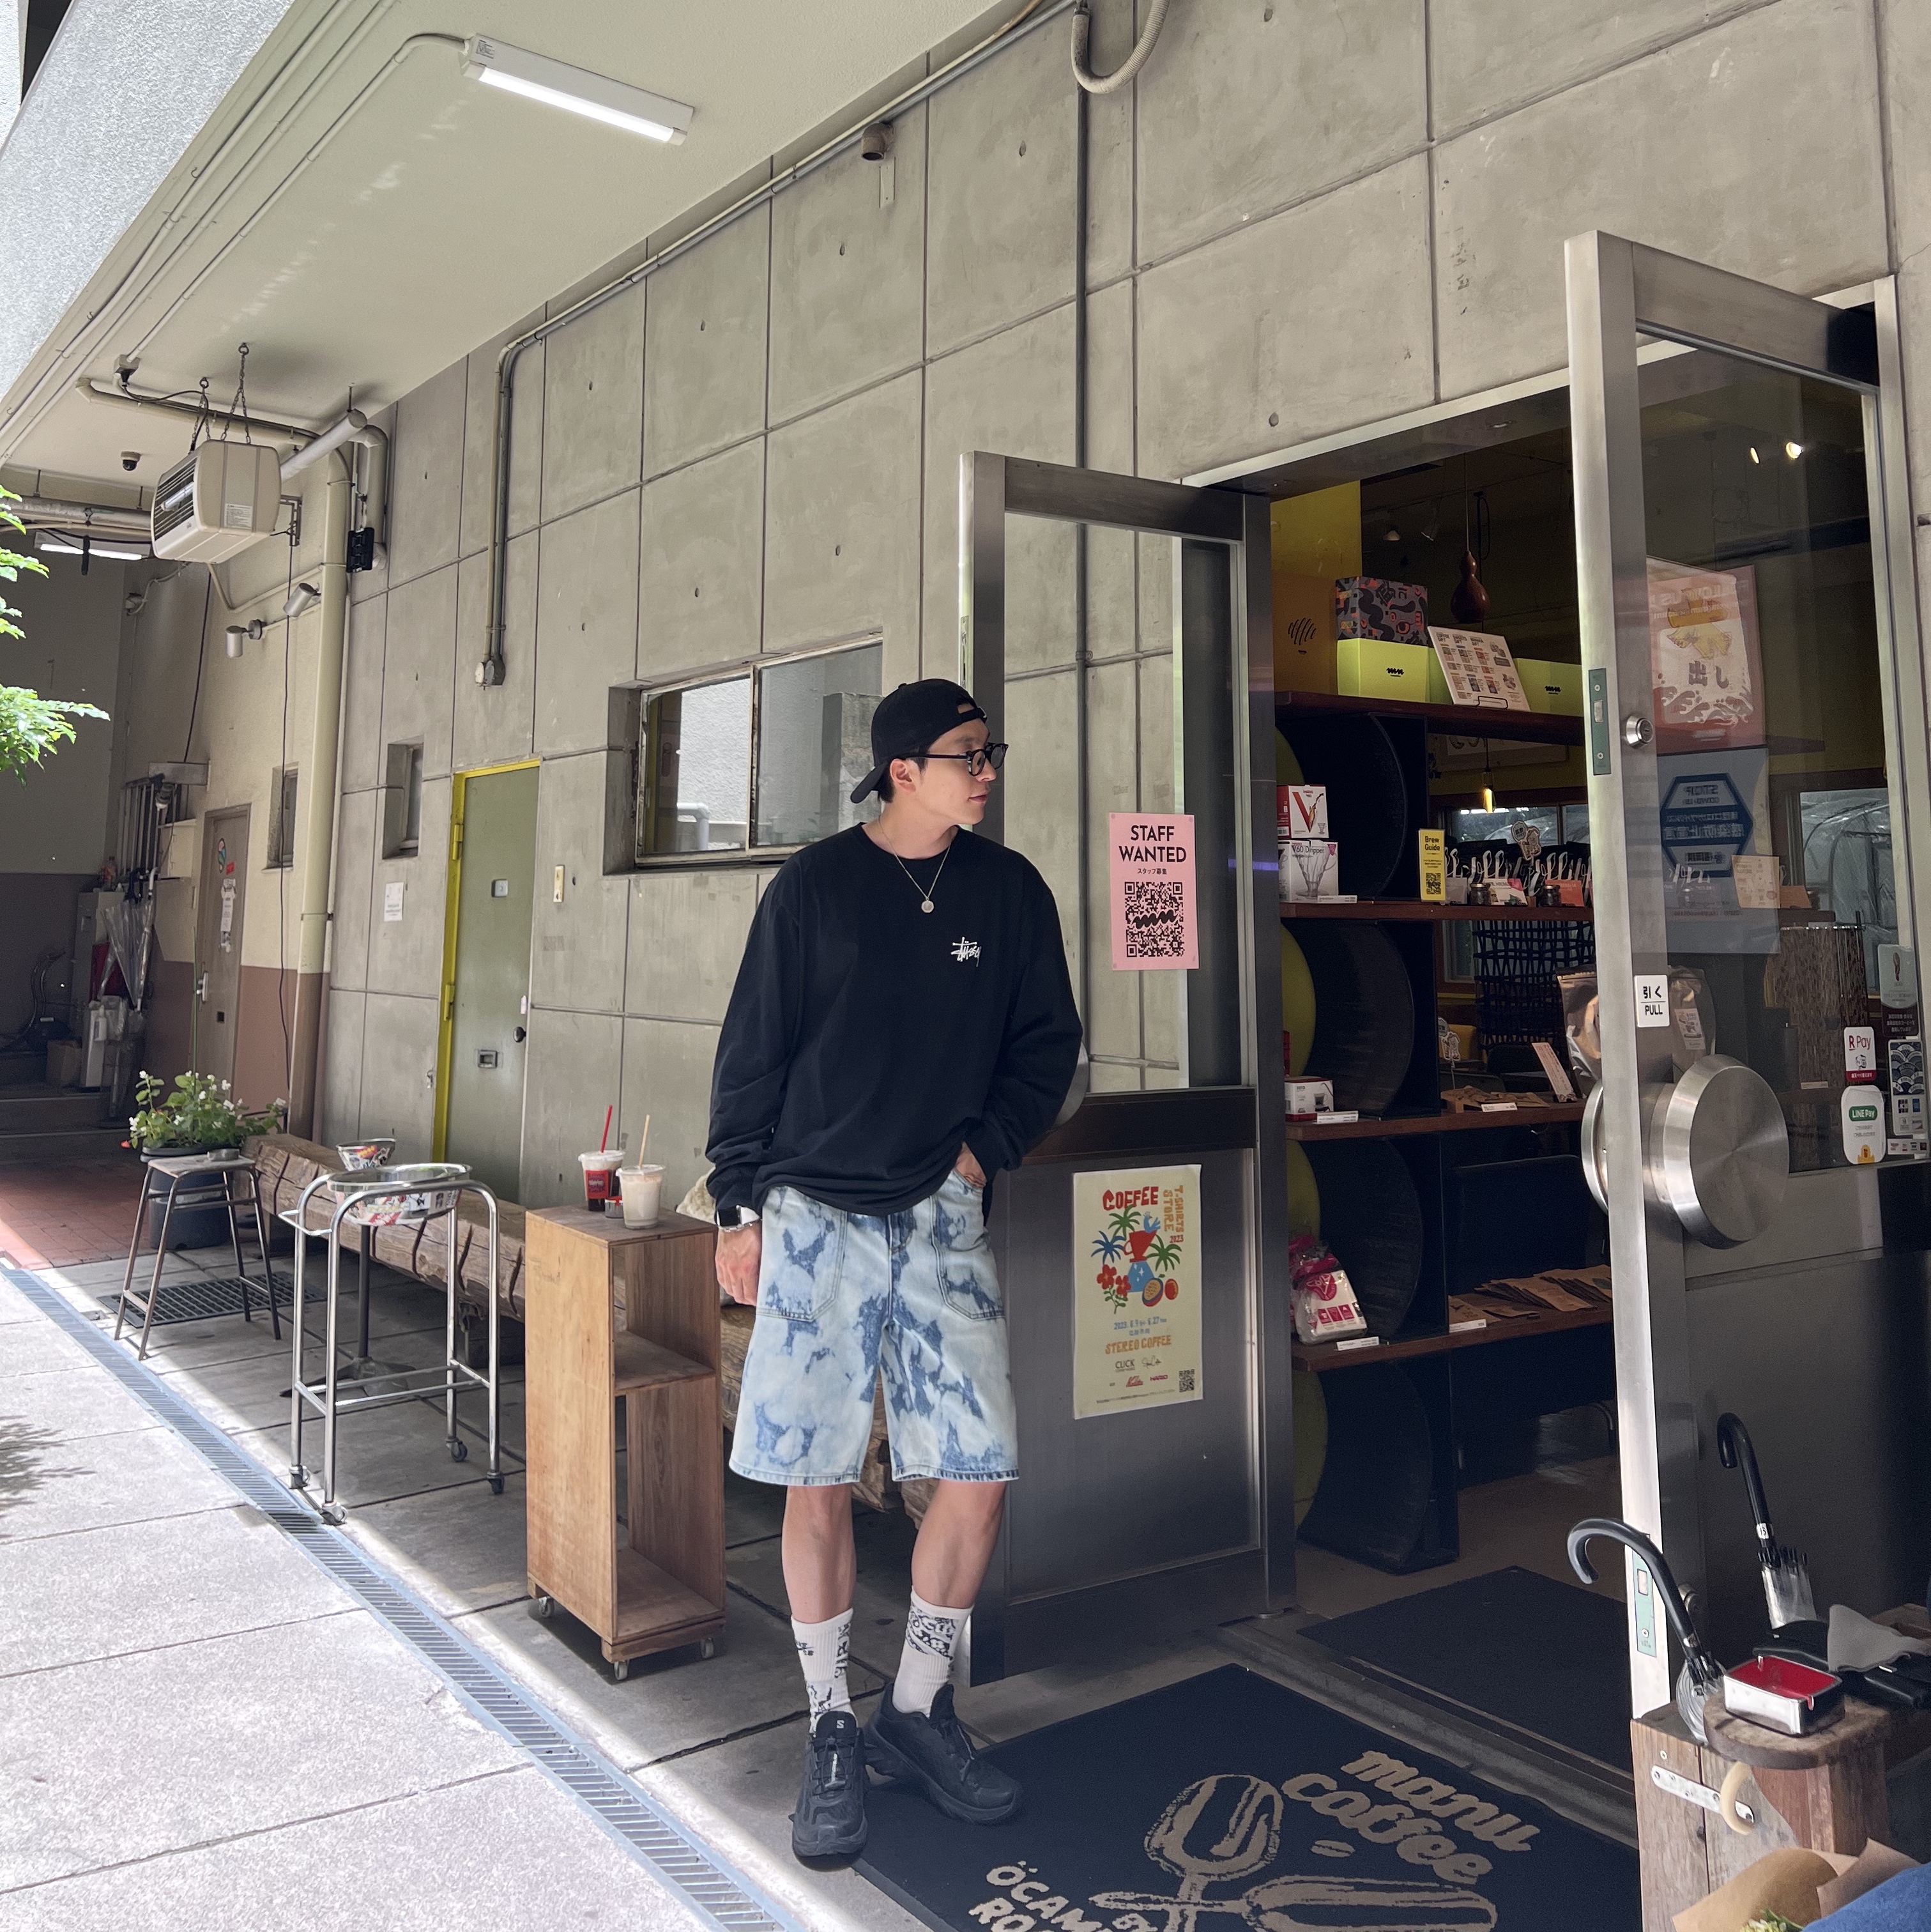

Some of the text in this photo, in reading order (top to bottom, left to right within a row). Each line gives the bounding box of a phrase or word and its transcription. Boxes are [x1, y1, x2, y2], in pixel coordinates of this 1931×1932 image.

[1131, 825, 1175, 841] STAFF
[1118, 845, 1187, 862] WANTED
[1305, 846, 1325, 855] Dripper
[1643, 985, 1662, 999] 引く
[1645, 1004, 1663, 1016] PULL
[1856, 1035, 1872, 1050] Pay
[1852, 1108, 1875, 1119] LINE Pay
[1103, 1186, 1159, 1211] COFFEE
[1163, 1189, 1174, 1232] STORE
[1174, 1184, 1184, 1232] T-SHIRTS
[1169, 1234, 1184, 1243] 2023
[1105, 1335, 1172, 1354] STEREO COFFEE
[1115, 1358, 1135, 1369] CLICK
[1340, 1750, 1541, 1852] manu
[1281, 1773, 1493, 1885] coffee
